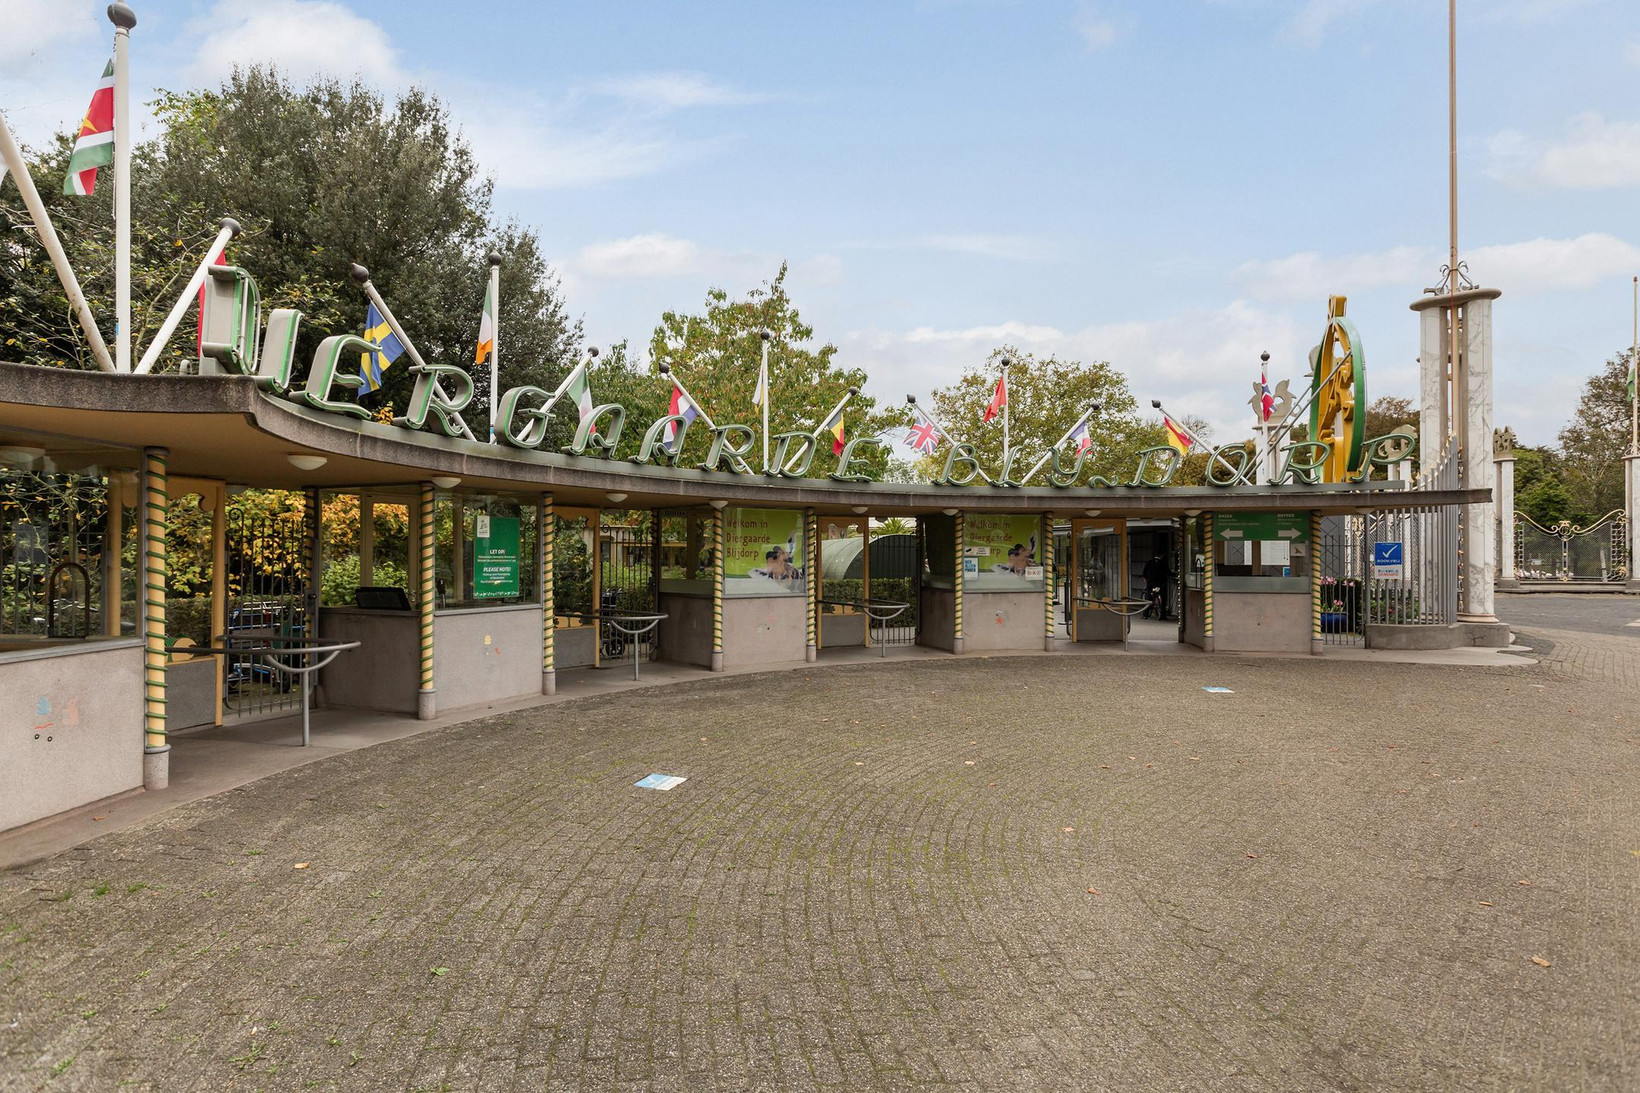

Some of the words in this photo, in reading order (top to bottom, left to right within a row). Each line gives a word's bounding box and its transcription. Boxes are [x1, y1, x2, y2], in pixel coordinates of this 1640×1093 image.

[727, 519, 757, 528] Welkom
[761, 519, 768, 528] in
[726, 532, 771, 547] Diergaarde
[726, 548, 759, 561] Blijdorp
